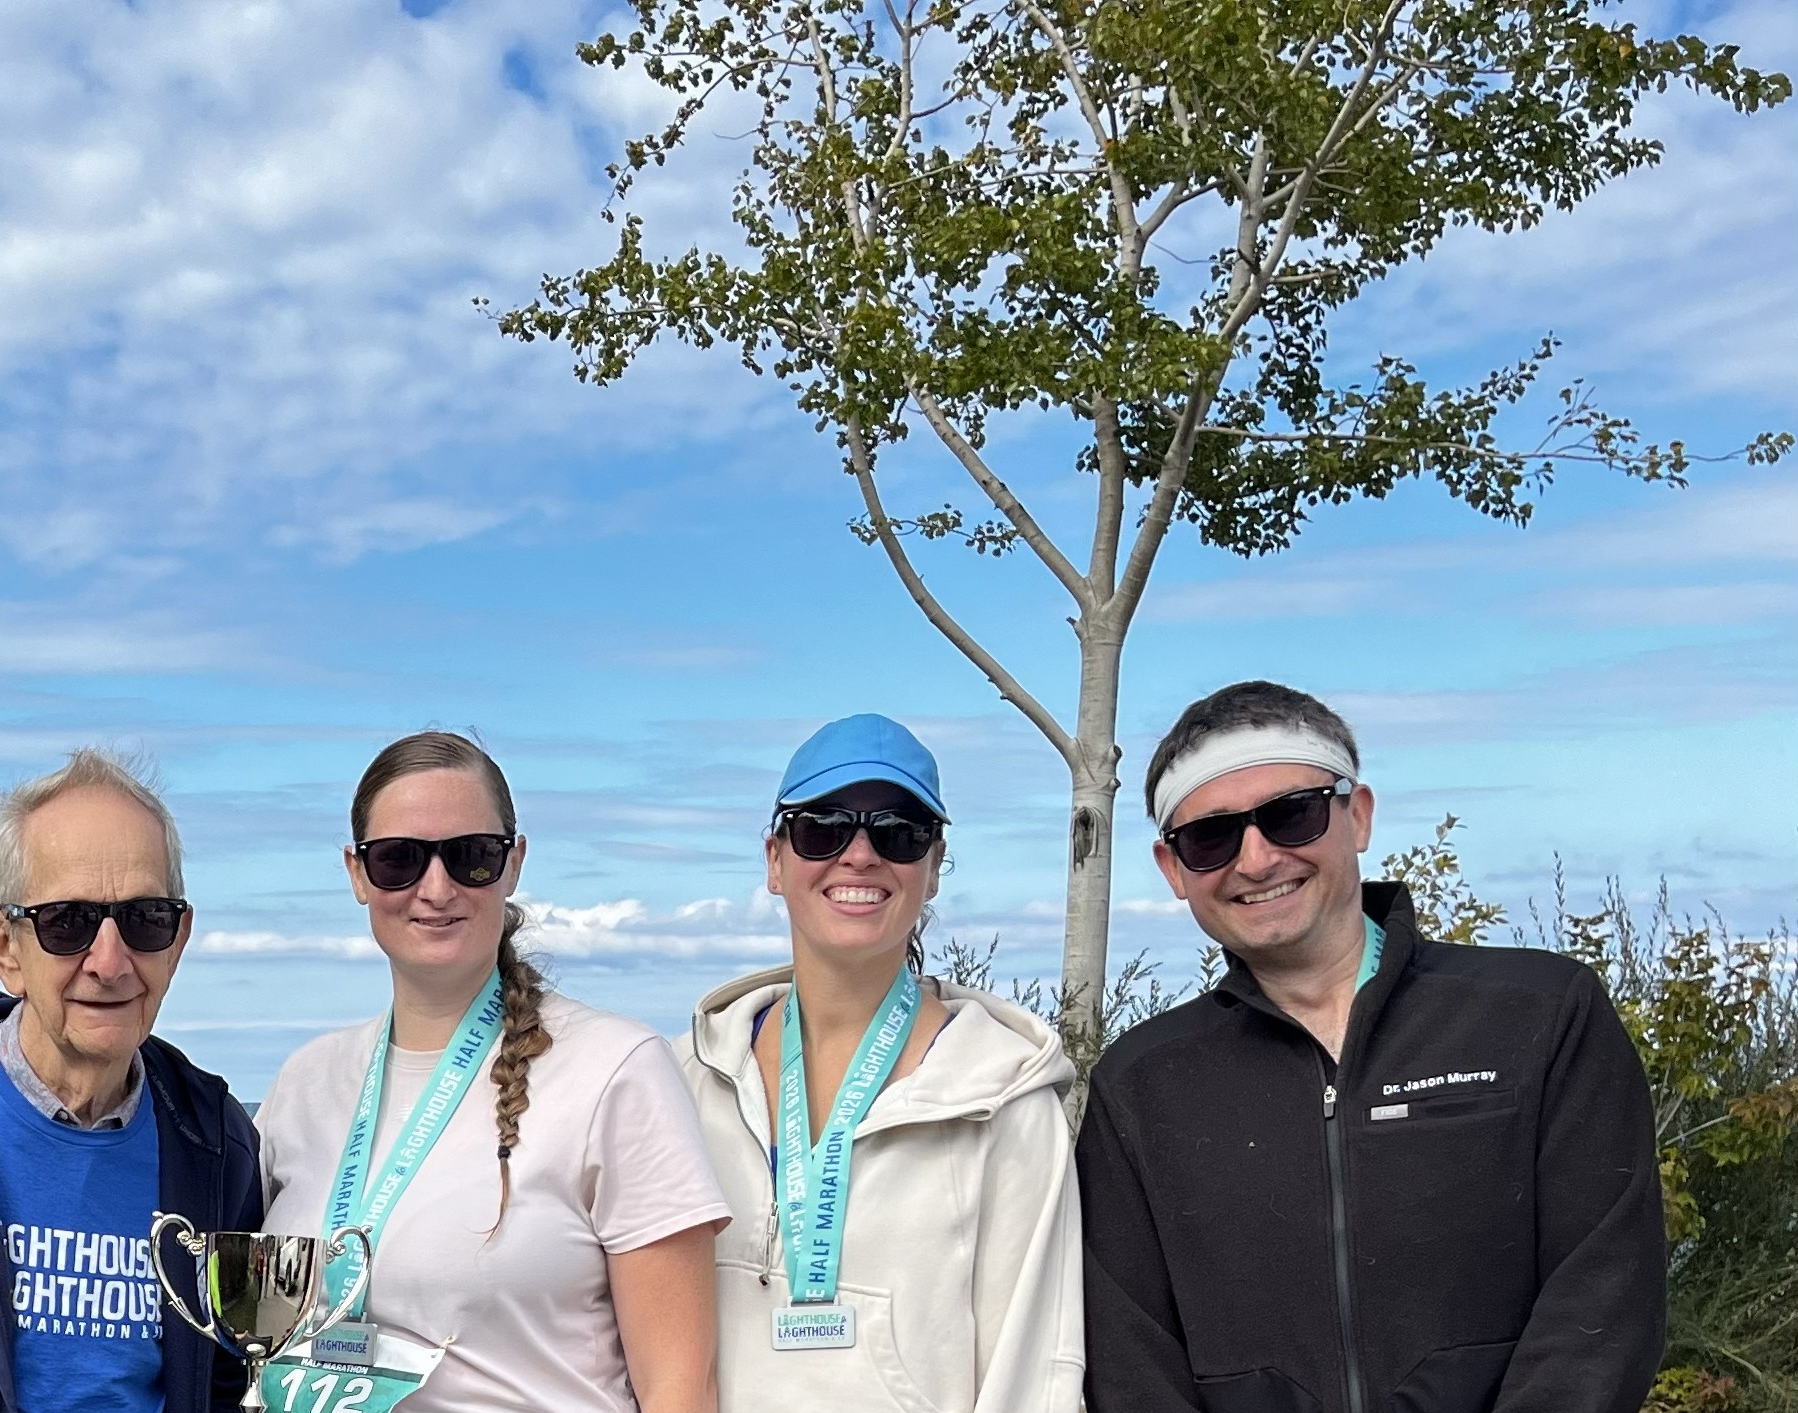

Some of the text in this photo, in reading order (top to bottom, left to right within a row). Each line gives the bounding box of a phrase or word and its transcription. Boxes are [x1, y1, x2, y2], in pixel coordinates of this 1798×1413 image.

[452, 1028, 484, 1070] HALF
[1383, 1070, 1497, 1095] Dr. Jason Murray
[834, 1090, 866, 1127] 2026
[348, 1119, 367, 1158] HALF
[331, 1164, 358, 1231] MARATH
[815, 1130, 846, 1230] MARATHON
[808, 1238, 831, 1284] HALF
[17, 1313, 130, 1339] MARATHON
[322, 1362, 369, 1374] MARATHON
